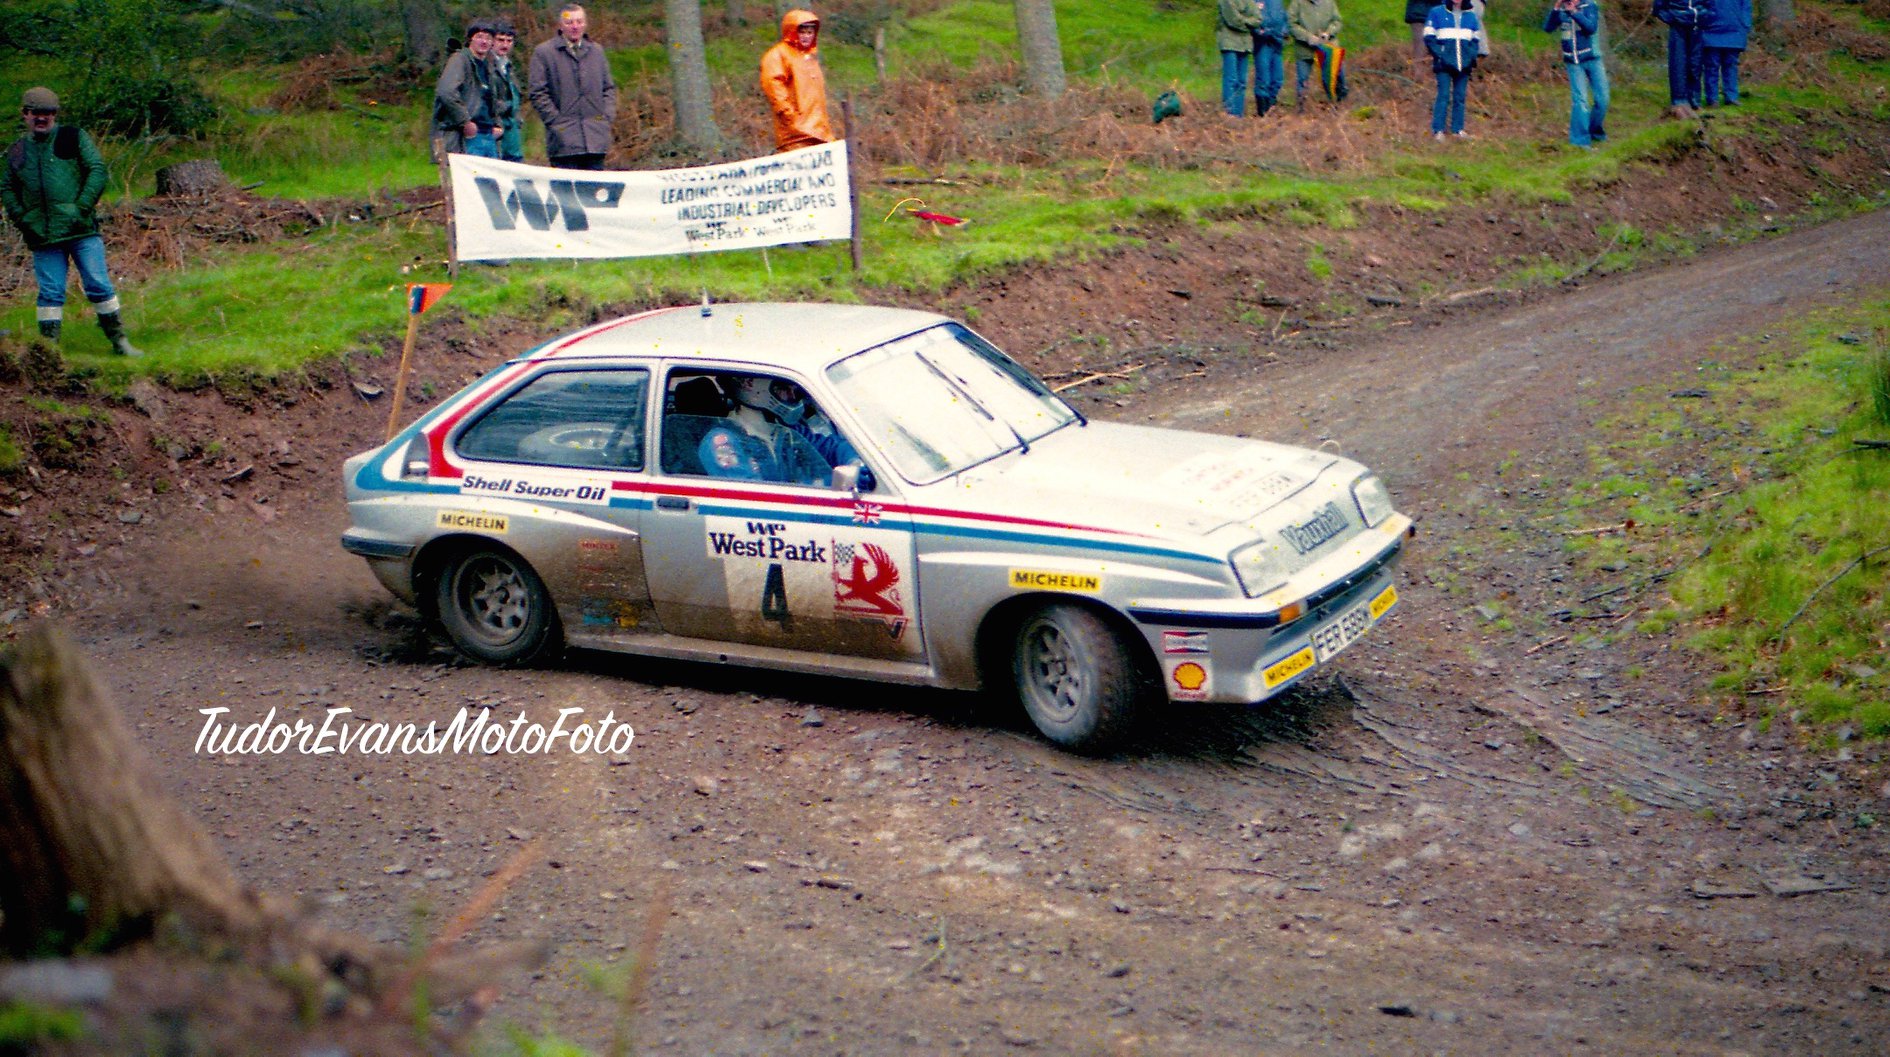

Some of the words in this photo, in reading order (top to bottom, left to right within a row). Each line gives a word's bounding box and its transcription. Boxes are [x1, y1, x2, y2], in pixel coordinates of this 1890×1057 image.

[661, 185, 719, 204] LEADING
[723, 176, 803, 197] COMMERCIAL
[808, 171, 836, 189] AND
[677, 201, 752, 220] INDUSTRIAL
[757, 193, 837, 215] DEVELOPERS
[463, 475, 512, 492] Shell
[514, 480, 575, 499] Super
[576, 485, 606, 500] Oil
[440, 513, 505, 530] MICHELIN
[1279, 501, 1349, 555] Vauxhall
[709, 531, 766, 557] West
[768, 537, 826, 562] Park
[1015, 572, 1097, 588] MICHELIN
